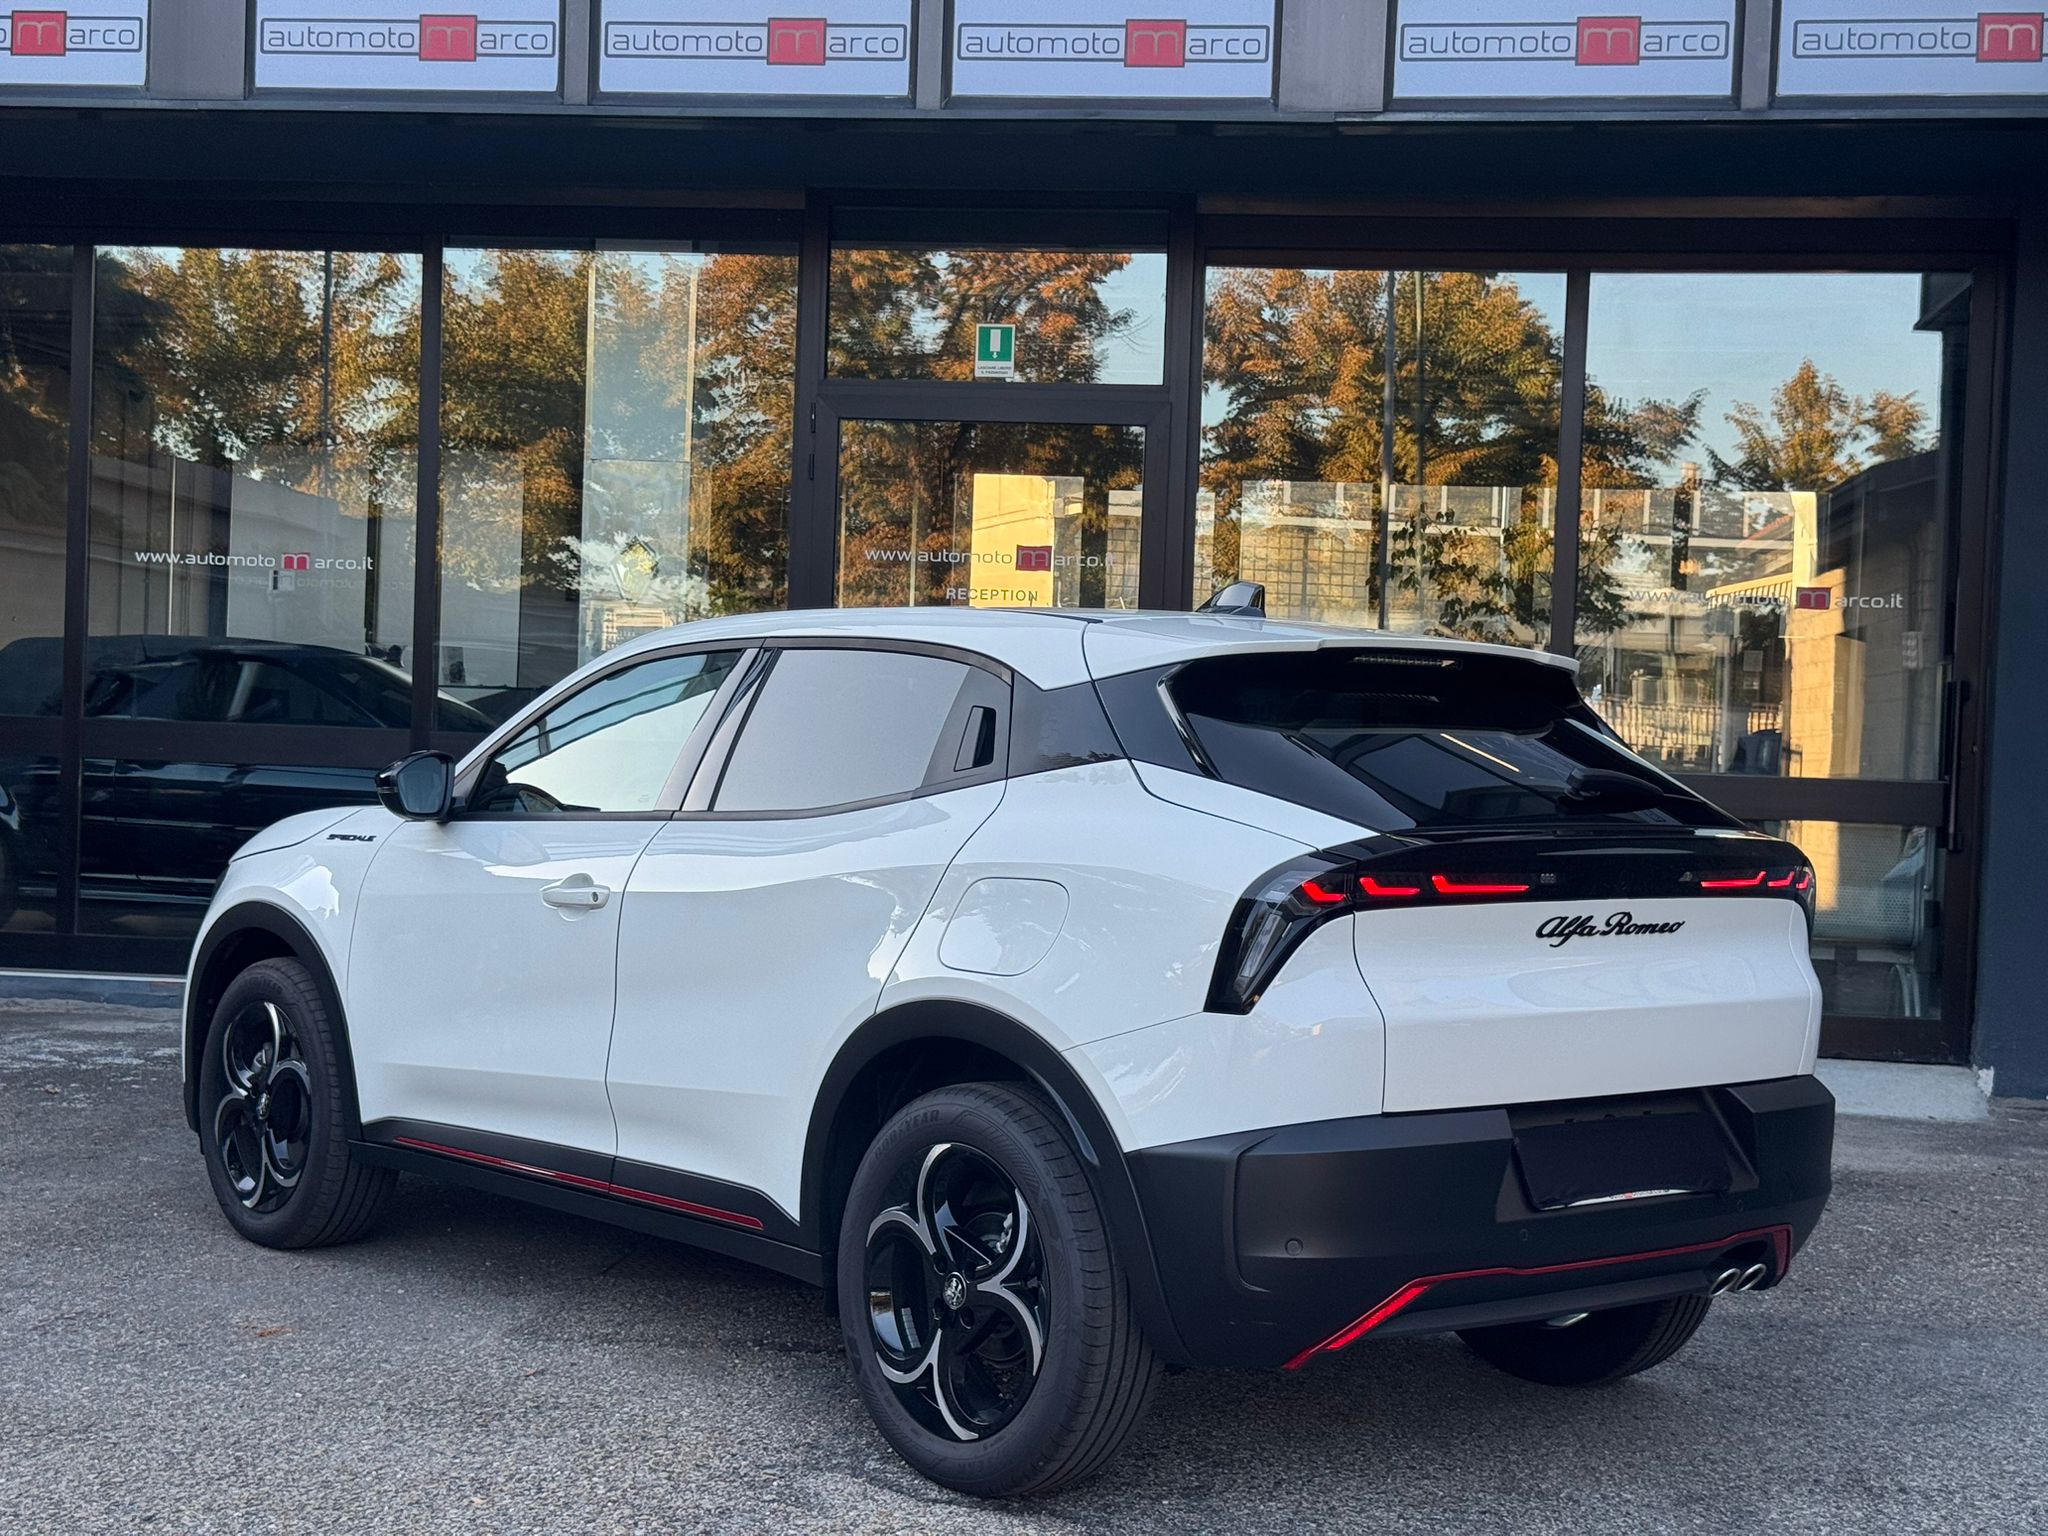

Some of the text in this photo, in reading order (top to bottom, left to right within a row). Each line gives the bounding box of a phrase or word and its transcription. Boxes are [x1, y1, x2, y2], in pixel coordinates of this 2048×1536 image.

[945, 587, 1038, 602] RECEPTION
[1535, 911, 1685, 948] Alfa Romeo
